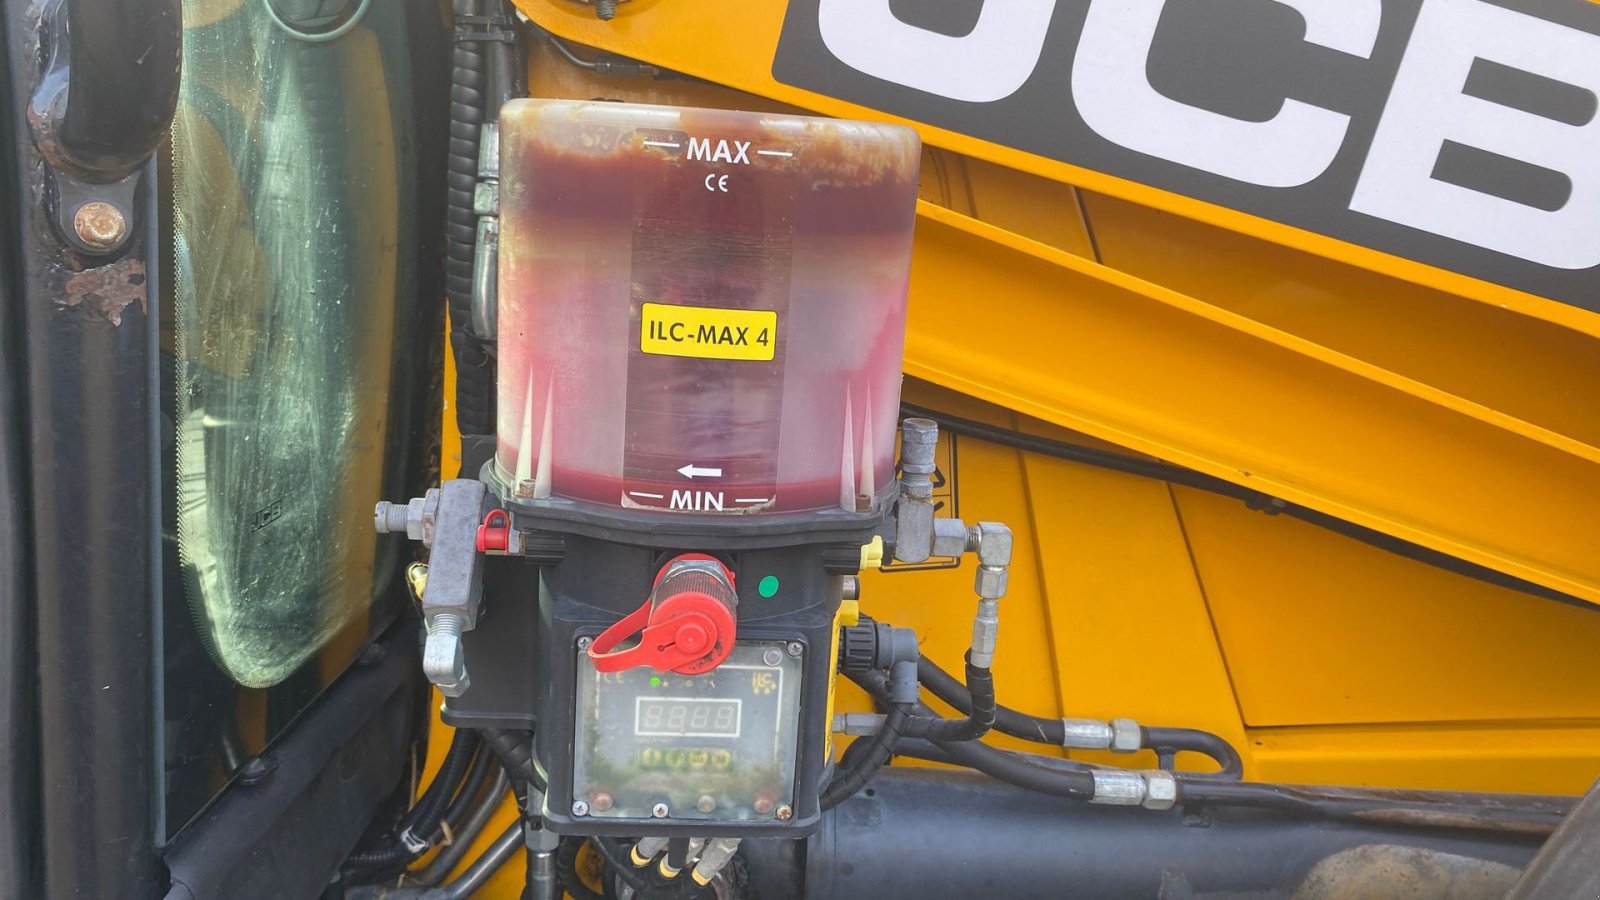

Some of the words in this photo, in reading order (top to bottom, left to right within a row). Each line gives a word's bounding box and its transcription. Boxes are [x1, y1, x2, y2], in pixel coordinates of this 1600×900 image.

[686, 137, 751, 165] MAX
[704, 173, 729, 193] CE
[649, 321, 749, 346] ILC-MAX
[756, 327, 769, 347] 4
[669, 489, 724, 512] MIN
[250, 500, 283, 533] JCB
